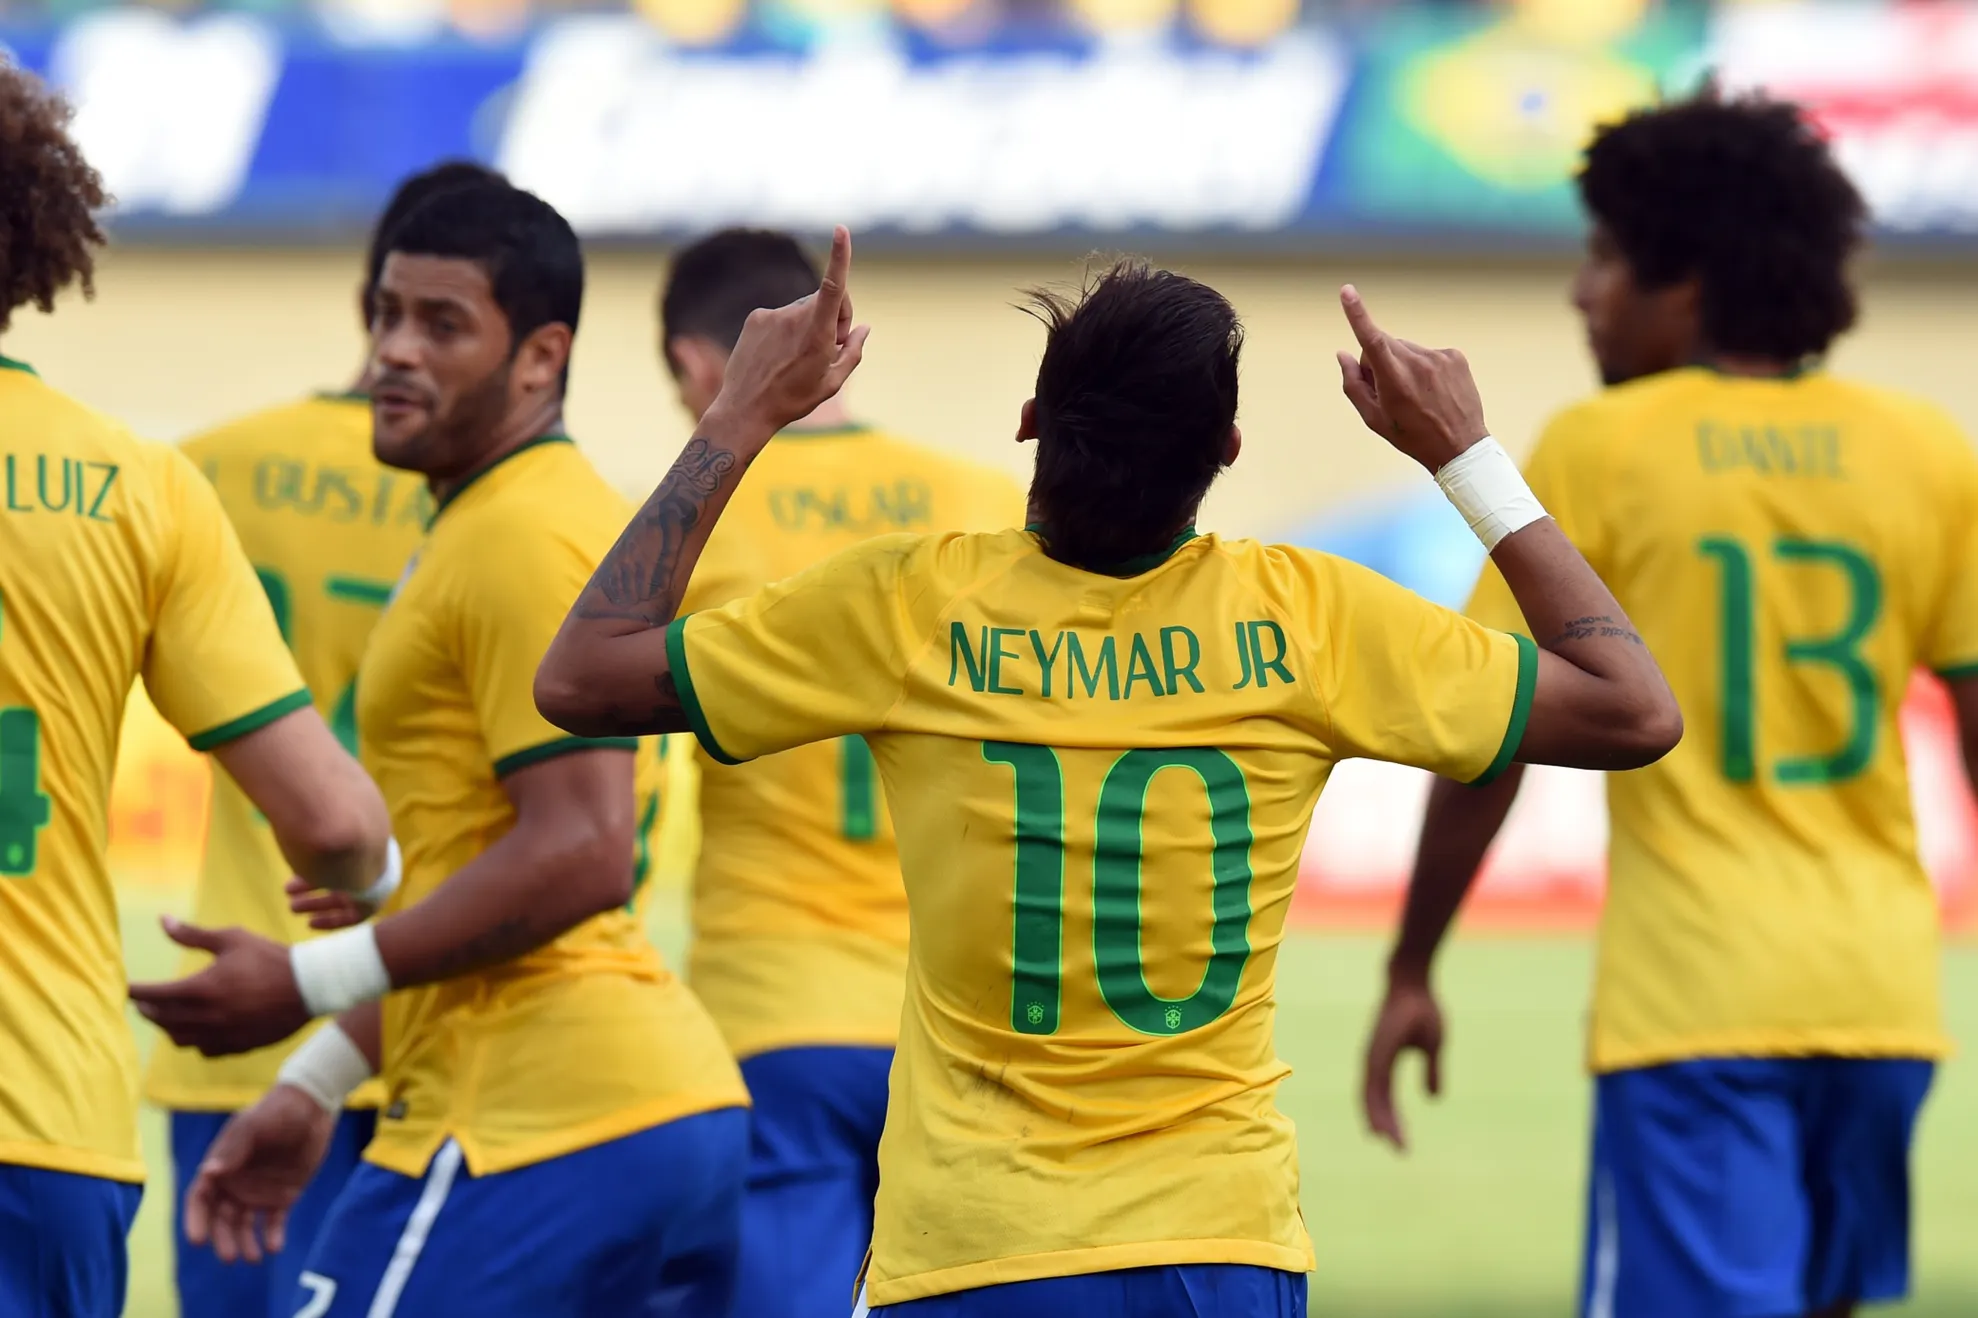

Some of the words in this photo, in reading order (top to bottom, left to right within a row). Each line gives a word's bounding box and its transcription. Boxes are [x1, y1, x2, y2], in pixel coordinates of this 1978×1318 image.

[6, 453, 119, 523] LUIZ
[1694, 418, 1848, 484] DANTE
[767, 476, 932, 534] OSCAR
[947, 621, 1206, 701] NEYMAR
[1232, 620, 1296, 690] JR
[1698, 531, 1884, 784] 13
[981, 740, 1254, 1037] 10
